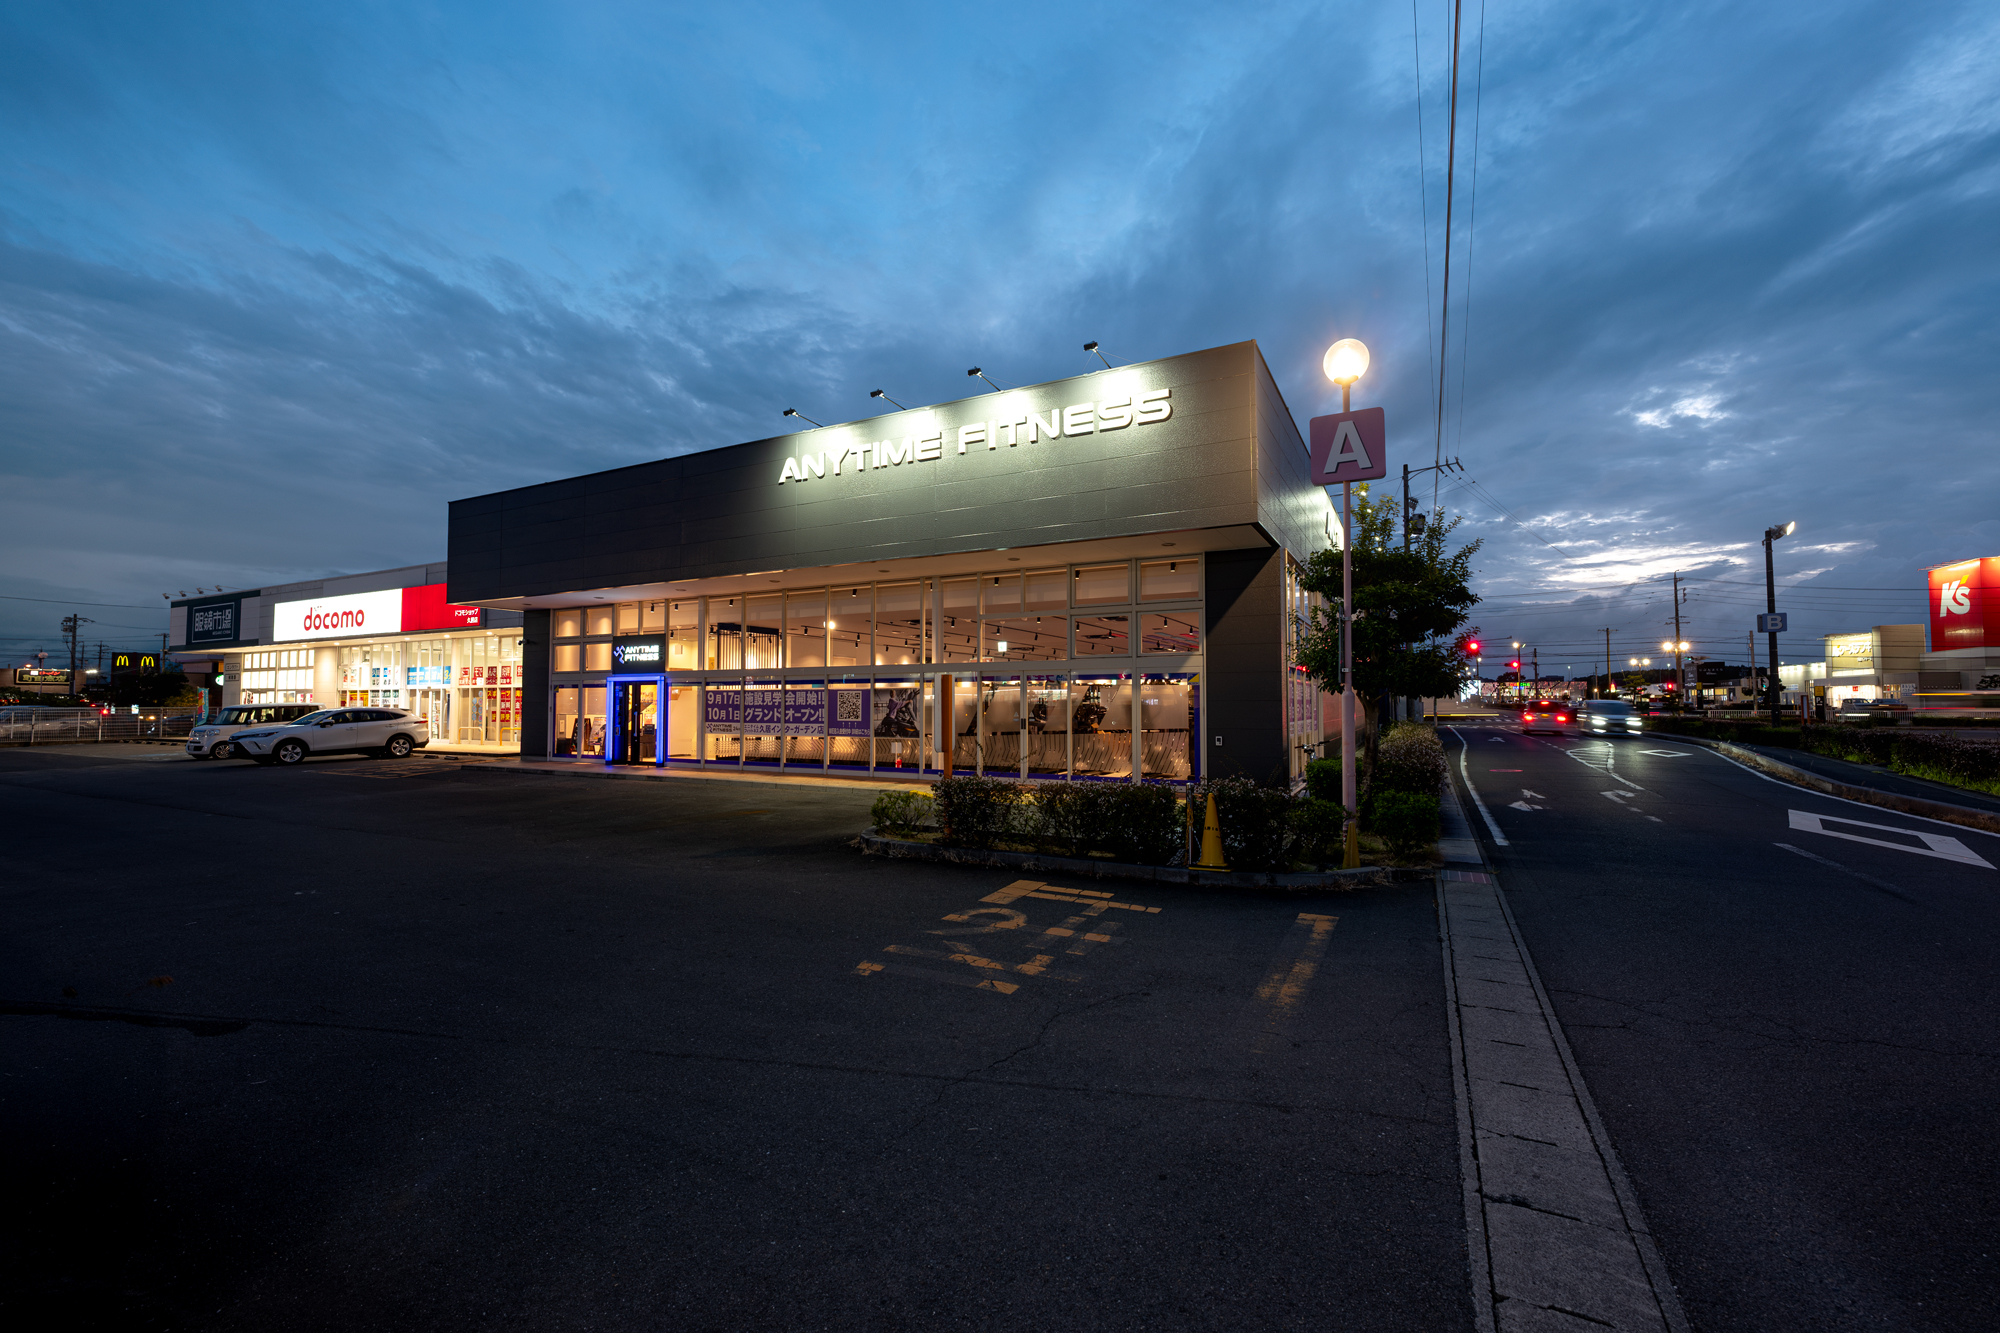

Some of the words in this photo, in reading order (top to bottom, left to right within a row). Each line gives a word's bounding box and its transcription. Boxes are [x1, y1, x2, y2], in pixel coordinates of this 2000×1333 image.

[778, 431, 942, 485] ANYTIME
[958, 388, 1173, 455] FITNESS
[1323, 420, 1374, 475] A
[194, 608, 232, 632] 眼鏡市場
[303, 606, 365, 632] docomo
[1767, 616, 1783, 630] B
[624, 653, 660, 662] FITNESS
[625, 644, 660, 654] ANYTIME
